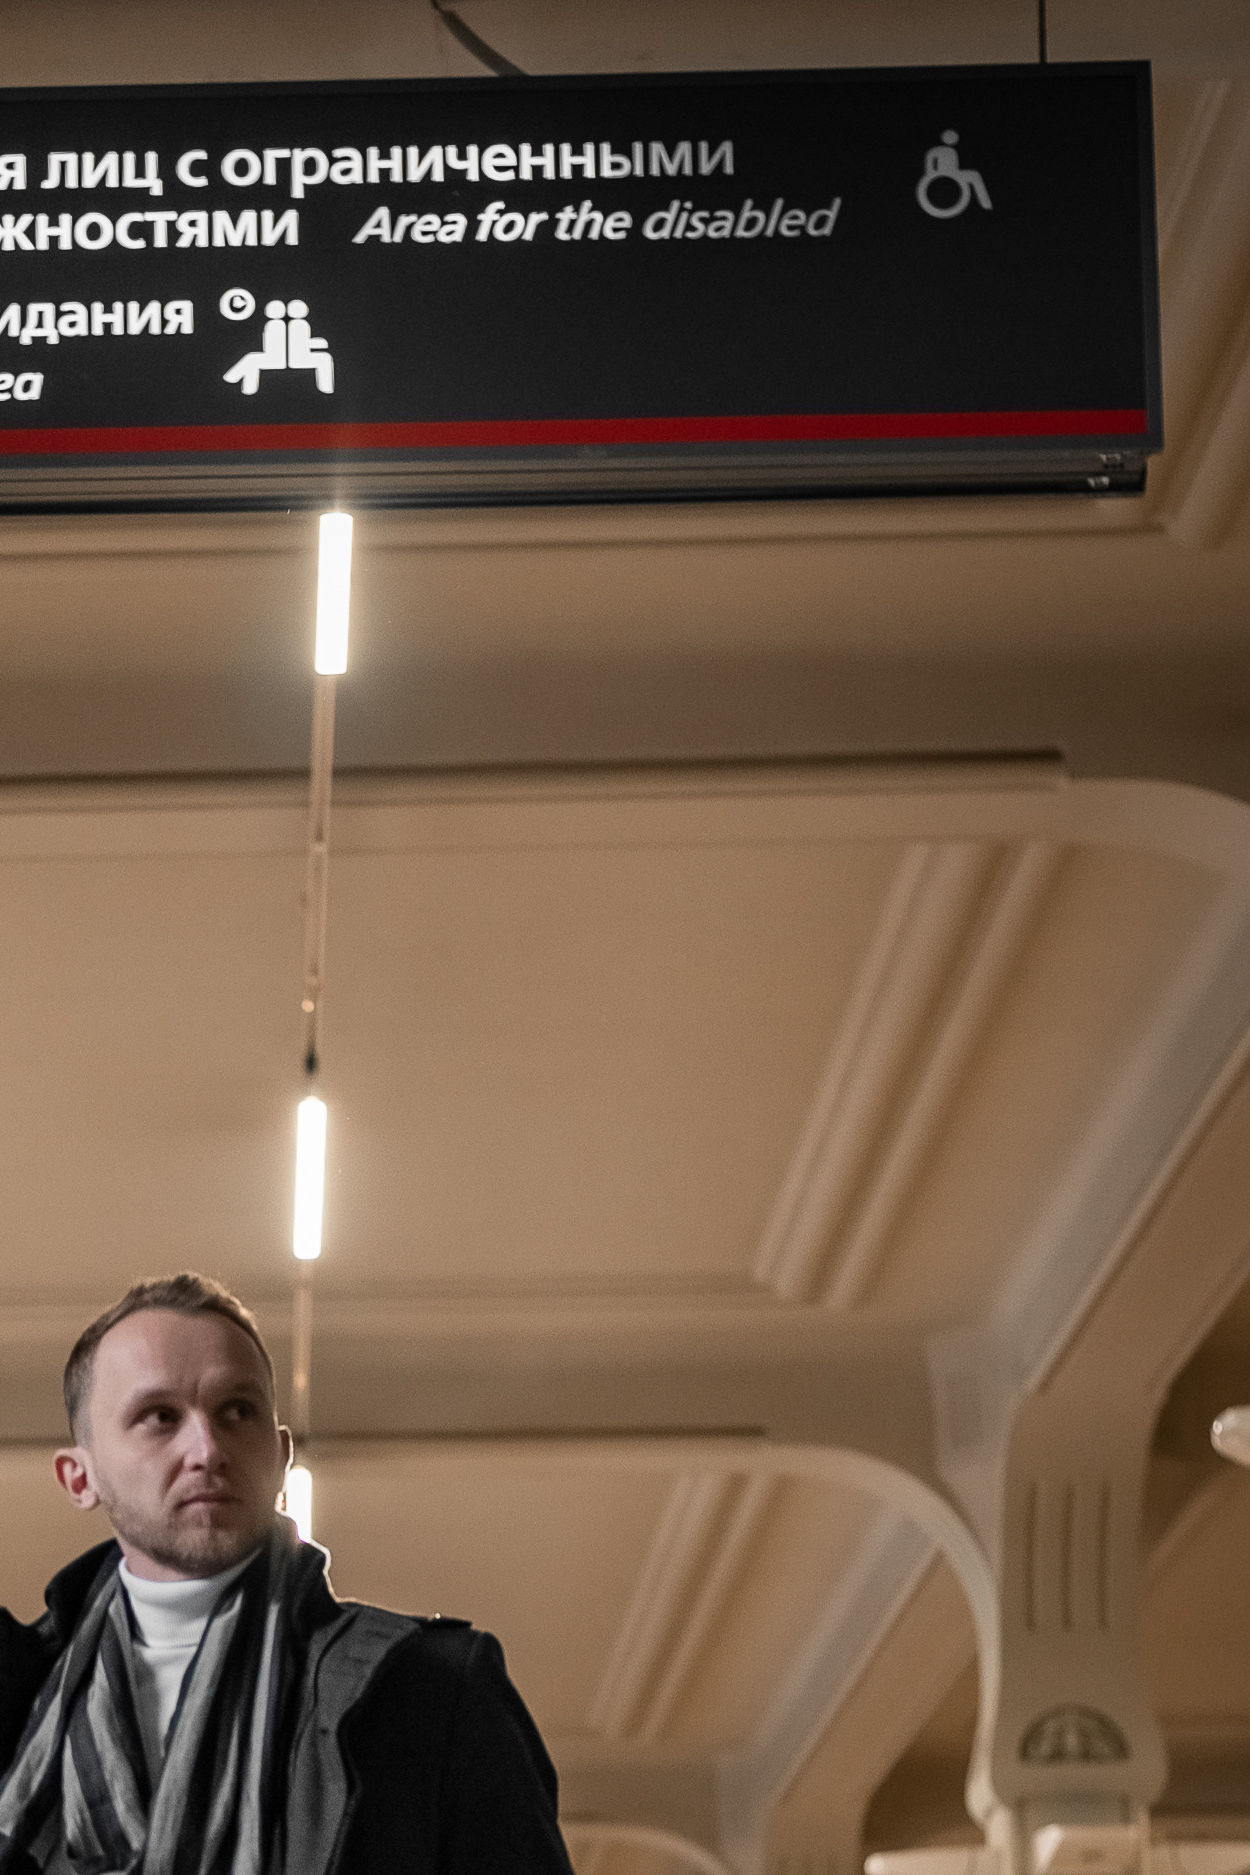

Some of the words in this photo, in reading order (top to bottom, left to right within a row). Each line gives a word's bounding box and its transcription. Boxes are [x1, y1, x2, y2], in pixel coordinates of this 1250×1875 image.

[40, 150, 164, 196] лиц
[175, 149, 209, 188] с
[220, 140, 736, 199] ограниченными
[350, 206, 468, 244] Area
[474, 200, 549, 242] for
[553, 199, 634, 241] the
[642, 198, 842, 240] disabled
